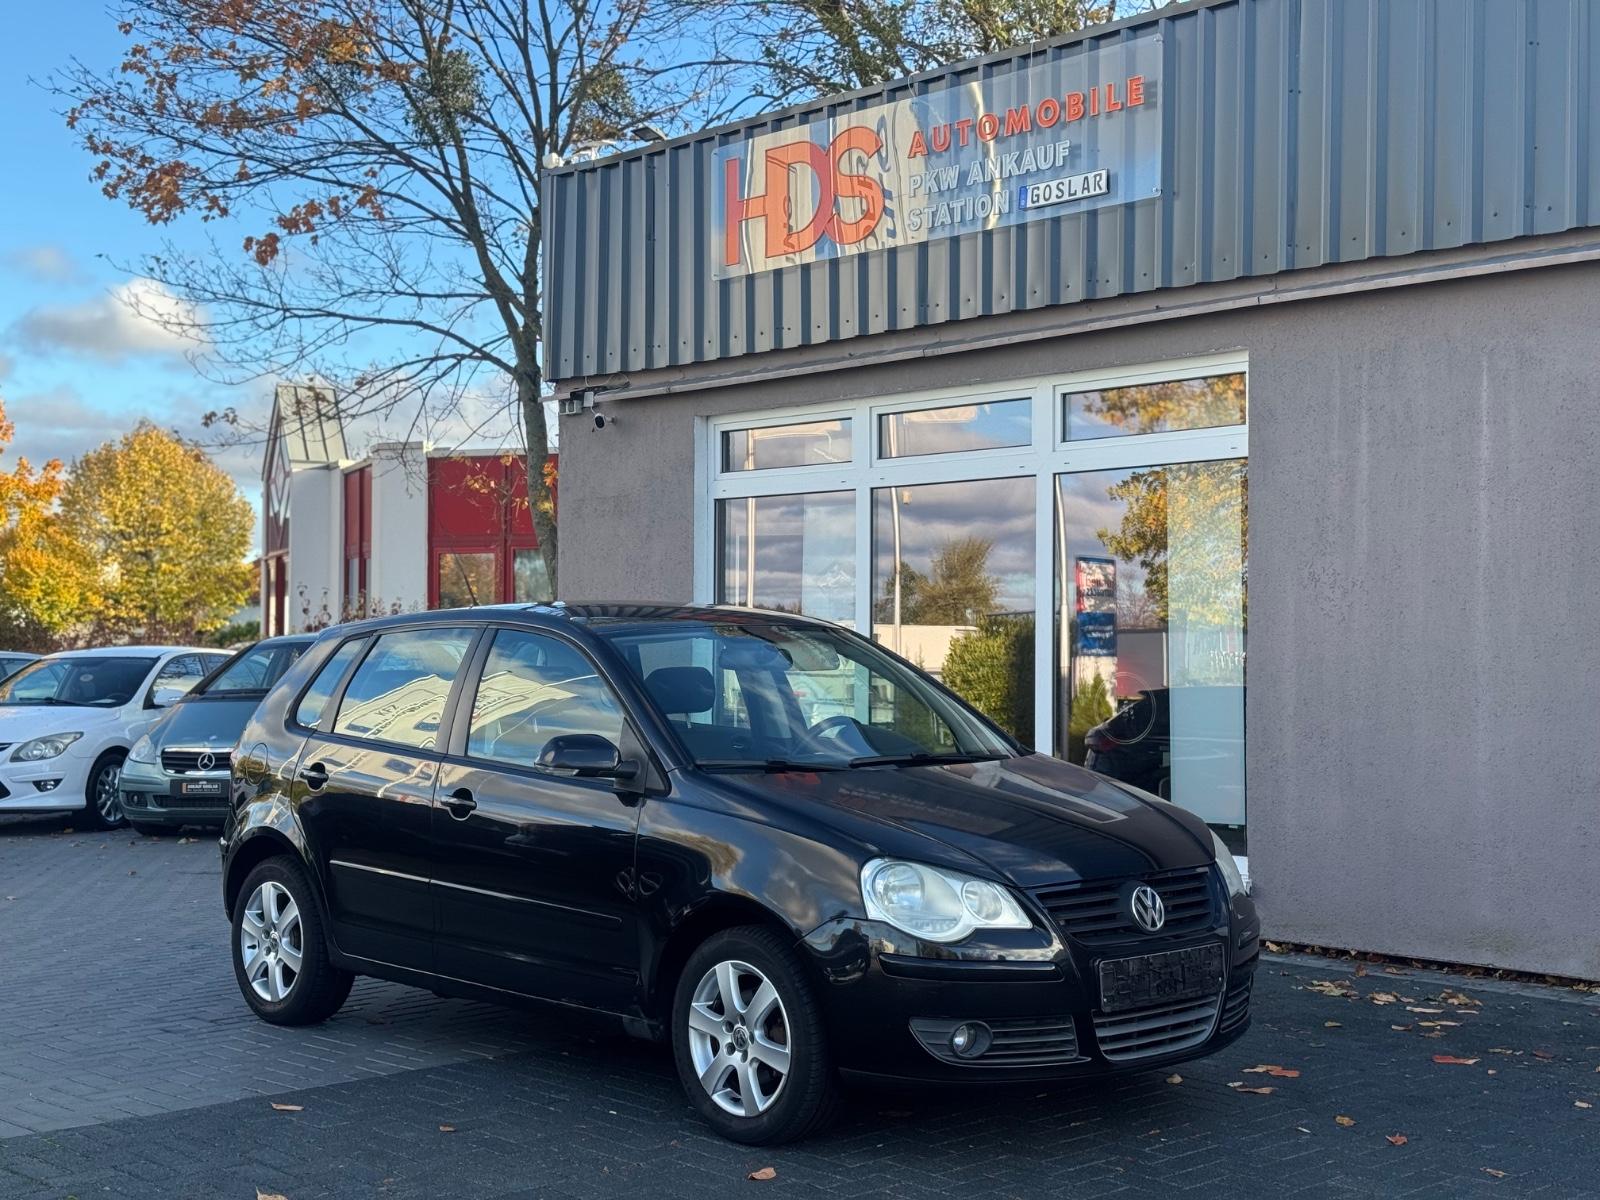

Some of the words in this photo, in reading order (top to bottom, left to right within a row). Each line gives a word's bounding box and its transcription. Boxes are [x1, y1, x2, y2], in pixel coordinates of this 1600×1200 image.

[907, 74, 1146, 159] AUTOMOBILE
[908, 163, 960, 198] PKW
[967, 139, 1072, 186] ANKAUF
[1030, 171, 1104, 206] GOSLAR
[725, 126, 885, 267] HDS
[907, 189, 1010, 232] STATION
[1131, 886, 1165, 932] VW
